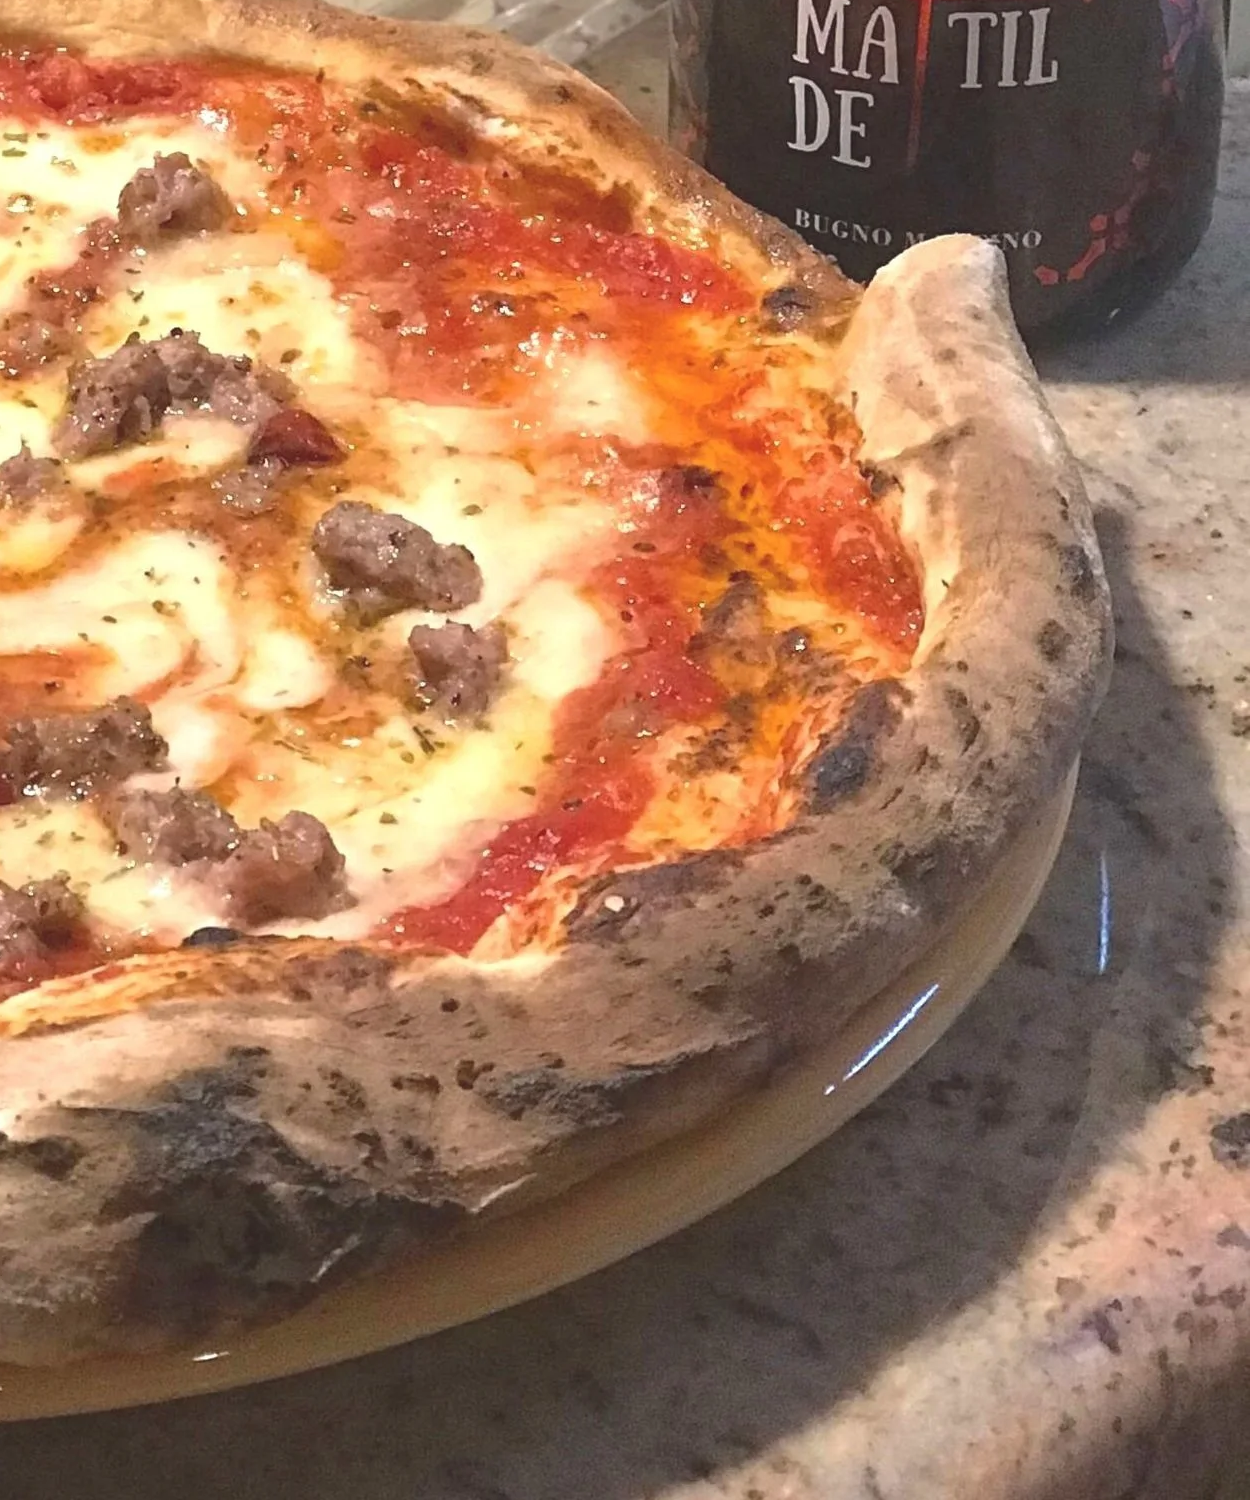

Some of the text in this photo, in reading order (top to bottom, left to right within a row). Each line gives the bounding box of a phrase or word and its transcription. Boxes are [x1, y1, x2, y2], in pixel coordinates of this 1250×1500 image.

[949, 7, 1059, 88] TIL
[787, 76, 875, 168] DE
[795, 208, 892, 247] BUGNO
